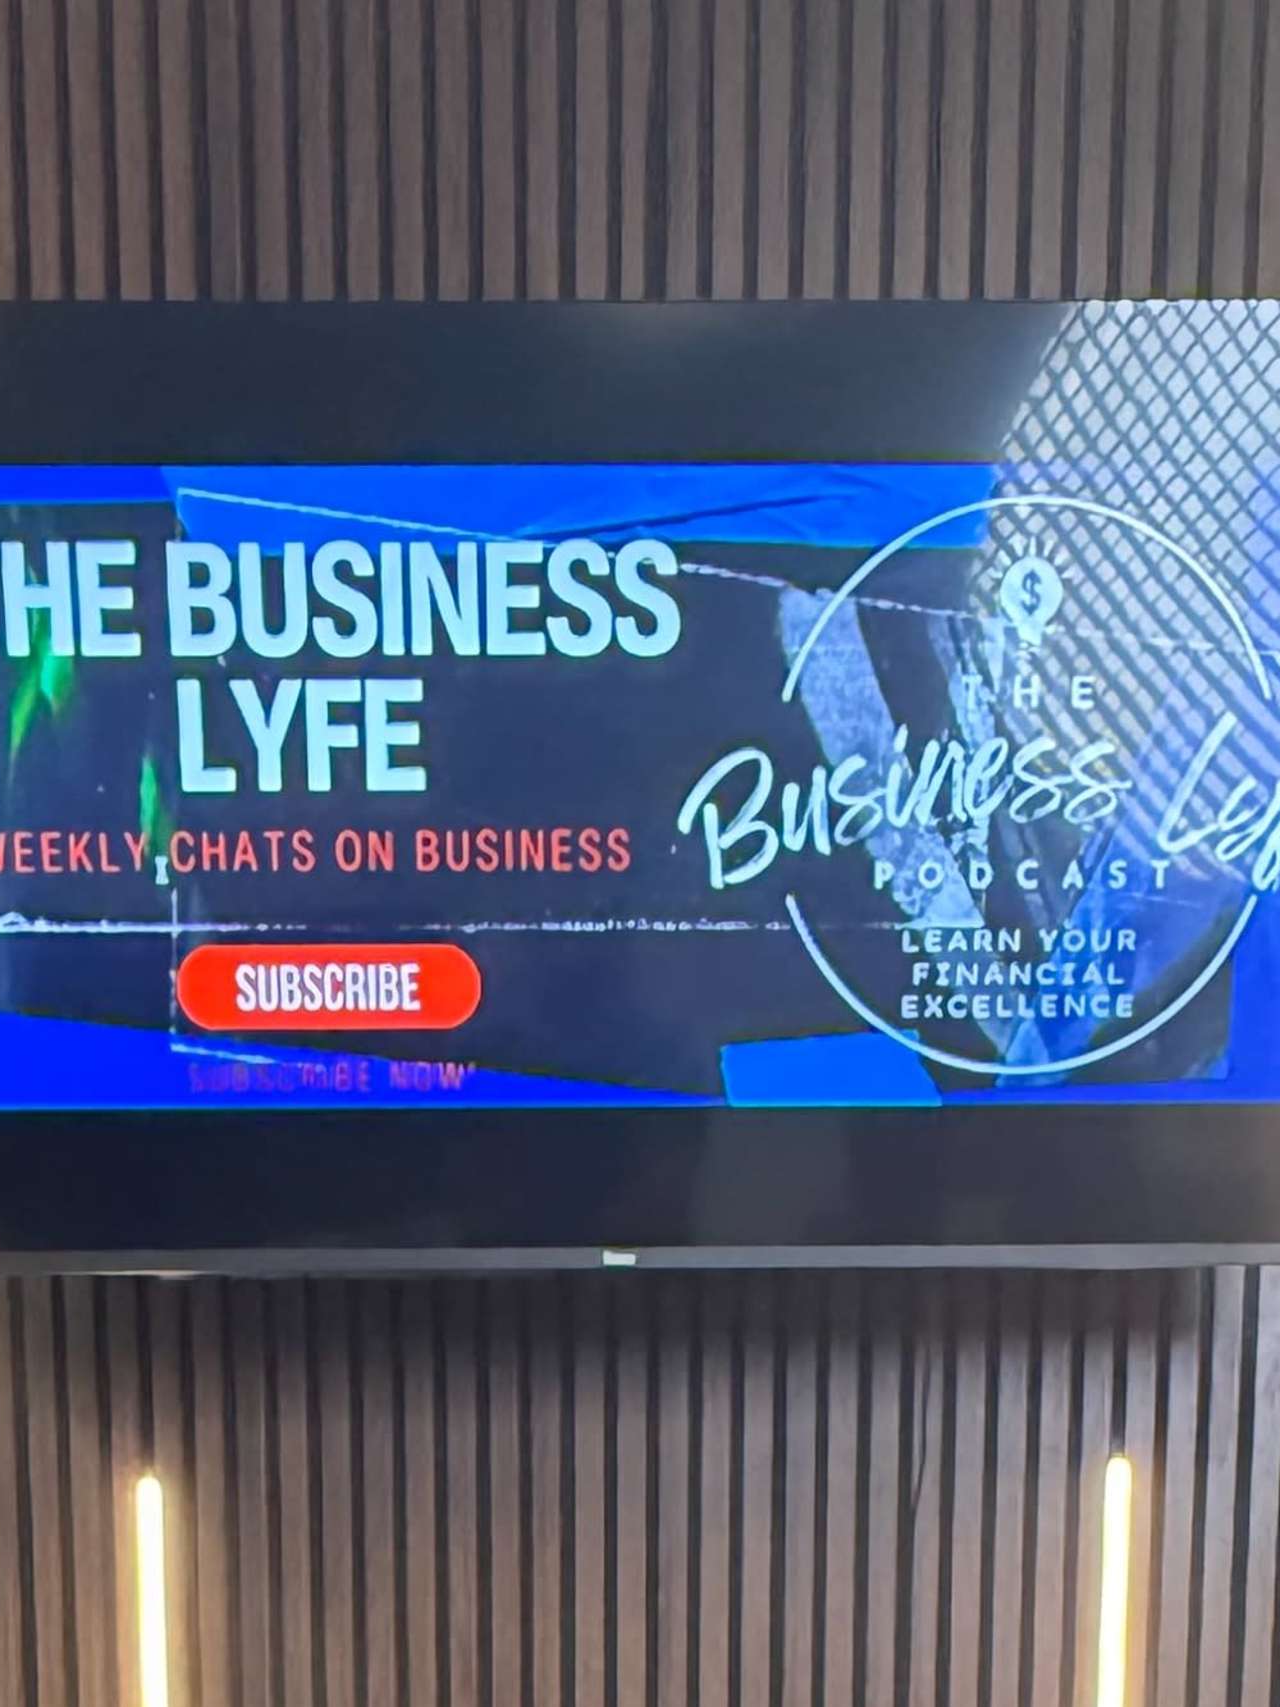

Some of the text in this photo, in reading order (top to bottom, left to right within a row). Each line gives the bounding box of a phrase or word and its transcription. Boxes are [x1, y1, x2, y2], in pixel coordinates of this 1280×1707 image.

[165, 538, 682, 658] BUSINESS
[961, 674, 1097, 709] THE
[176, 677, 428, 793] LYFE
[677, 724, 1133, 890] Business
[169, 829, 316, 872] CHATS
[334, 829, 395, 871] ON
[416, 828, 632, 872] BUSINESS
[873, 858, 1171, 890] PODCAST
[901, 926, 1137, 953] LEARN YOUR
[234, 962, 421, 1013] SUBSCRIBE
[911, 961, 1125, 986] FINANCIAL
[900, 993, 1135, 1019] EXCELLENCE
